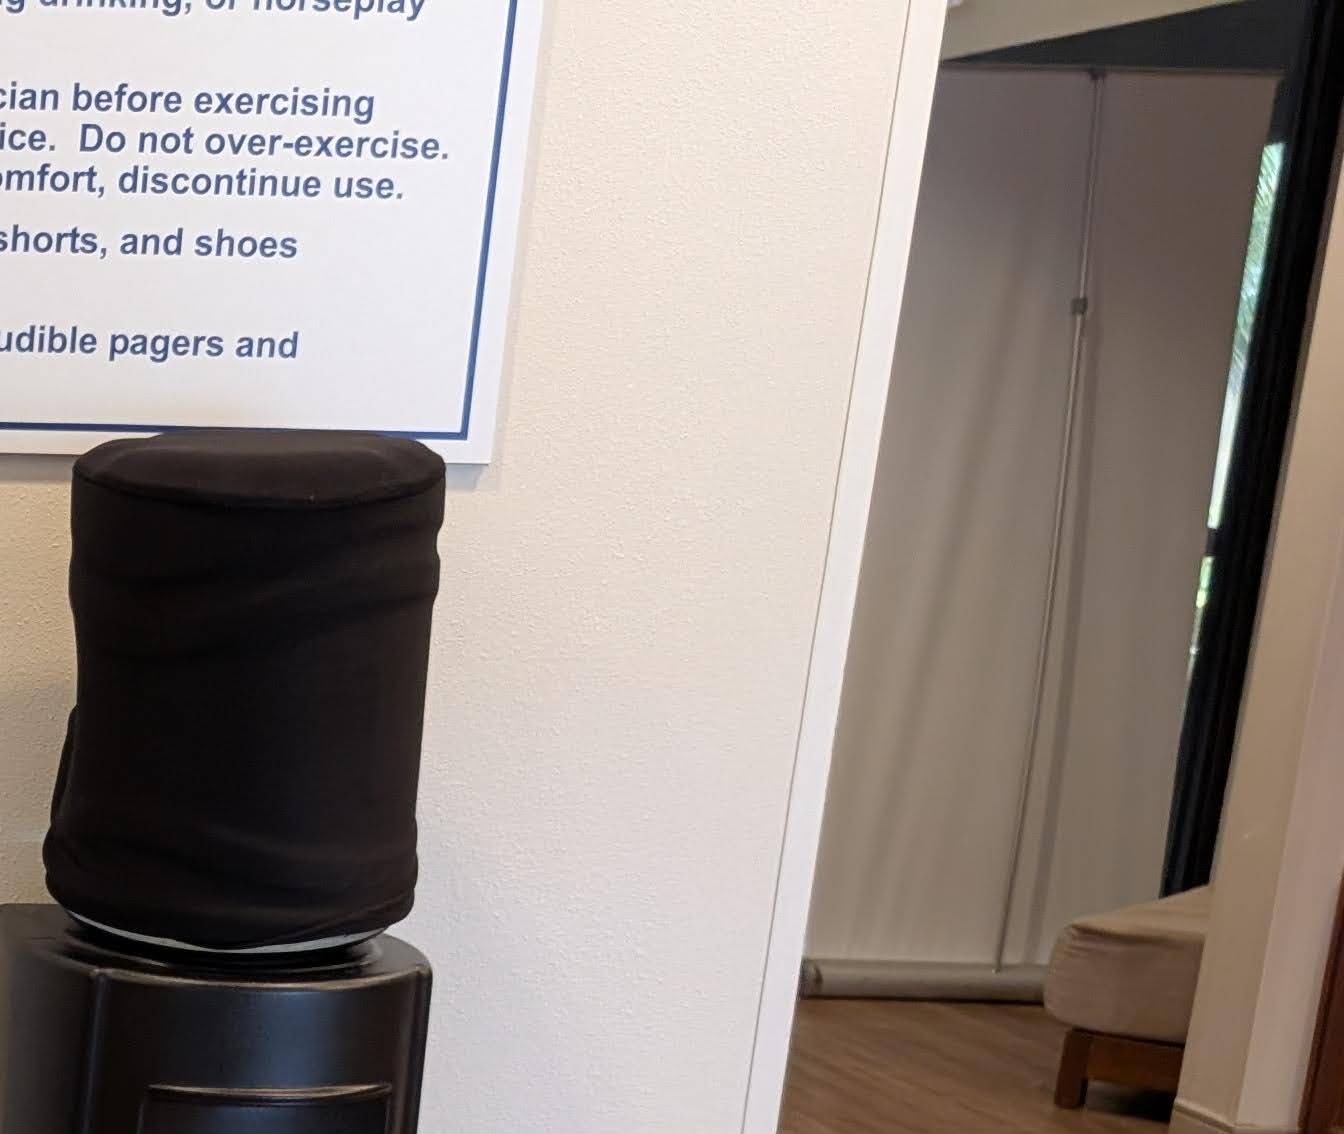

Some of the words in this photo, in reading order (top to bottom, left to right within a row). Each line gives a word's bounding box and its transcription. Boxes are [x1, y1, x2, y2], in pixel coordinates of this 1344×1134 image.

[72, 82, 182, 114] before
[194, 86, 375, 125] exercising
[79, 123, 126, 153] Do
[138, 126, 195, 155] not
[205, 130, 448, 160] over-exercise.
[118, 165, 321, 198] discontinue
[334, 177, 403, 200] use.
[119, 227, 184, 256] and
[194, 228, 297, 259] shoes
[108, 333, 224, 363] pagers
[235, 331, 299, 359] and
